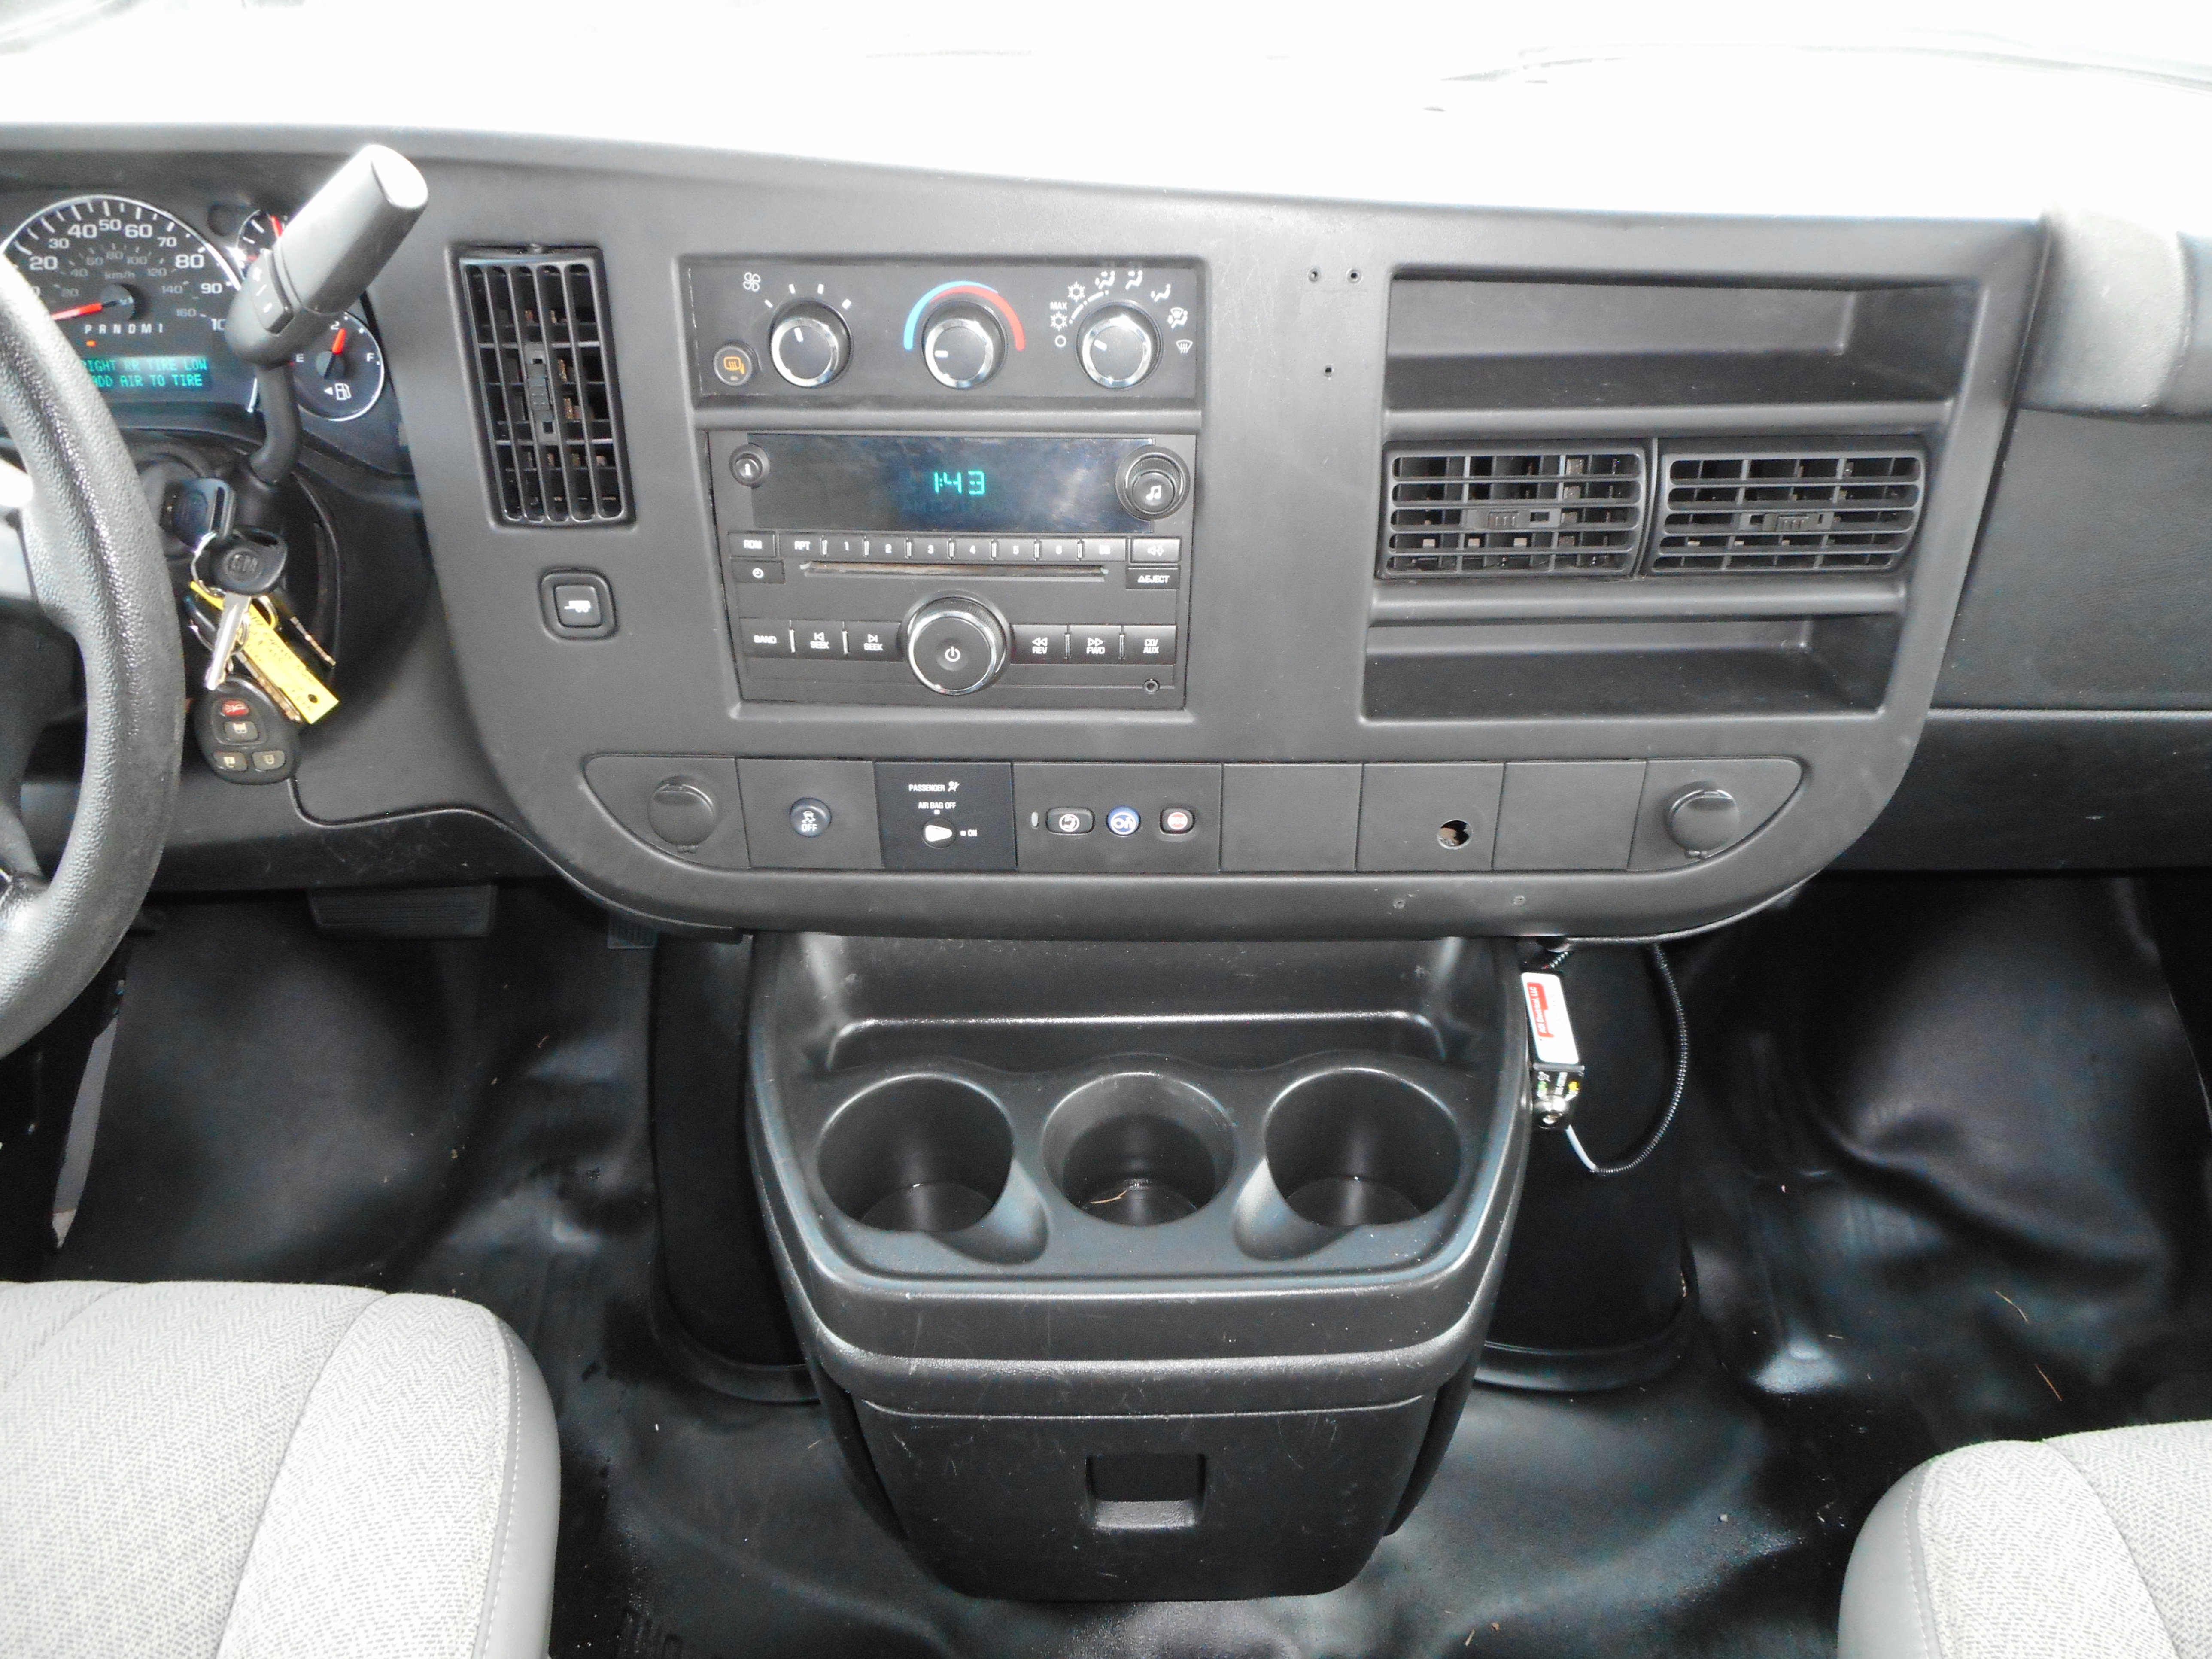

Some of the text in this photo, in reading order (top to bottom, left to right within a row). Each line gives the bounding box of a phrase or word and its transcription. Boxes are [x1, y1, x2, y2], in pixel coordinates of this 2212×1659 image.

[98, 219, 122, 231] 50
[67, 224, 97, 239] 40
[124, 224, 153, 238] 60
[49, 238, 70, 249] 30
[157, 237, 177, 247] 70
[30, 256, 58, 270] 20
[175, 254, 204, 269] 80
[104, 271, 136, 280] km/h
[147, 267, 167, 277] 120
[161, 285, 183, 294] 140
[200, 283, 222, 294] 90
[1050, 301, 1067, 310] MAX
[176, 308, 197, 317] 160
[296, 354, 304, 362] E
[366, 352, 374, 362] F
[148, 358, 177, 371] TIRE
[183, 358, 207, 371] LOW
[119, 375, 143, 387] AIR
[150, 375, 166, 386] TO
[172, 374, 203, 386] TIRE
[934, 471, 985, 495] 1:43
[794, 540, 811, 550] RPT
[844, 541, 849, 551] 1
[885, 544, 892, 553] 2
[927, 544, 934, 554] 3
[969, 545, 976, 554] 4
[1013, 545, 1019, 555] 5
[1056, 545, 1062, 555] 6
[753, 635, 778, 644] BAND
[810, 641, 830, 649] SEEK
[863, 643, 883, 651] SEEK
[1032, 646, 1048, 654] REV
[1086, 646, 1106, 654] FWD
[801, 823, 817, 832] OFF
[1529, 986, 1540, 997] LLC
